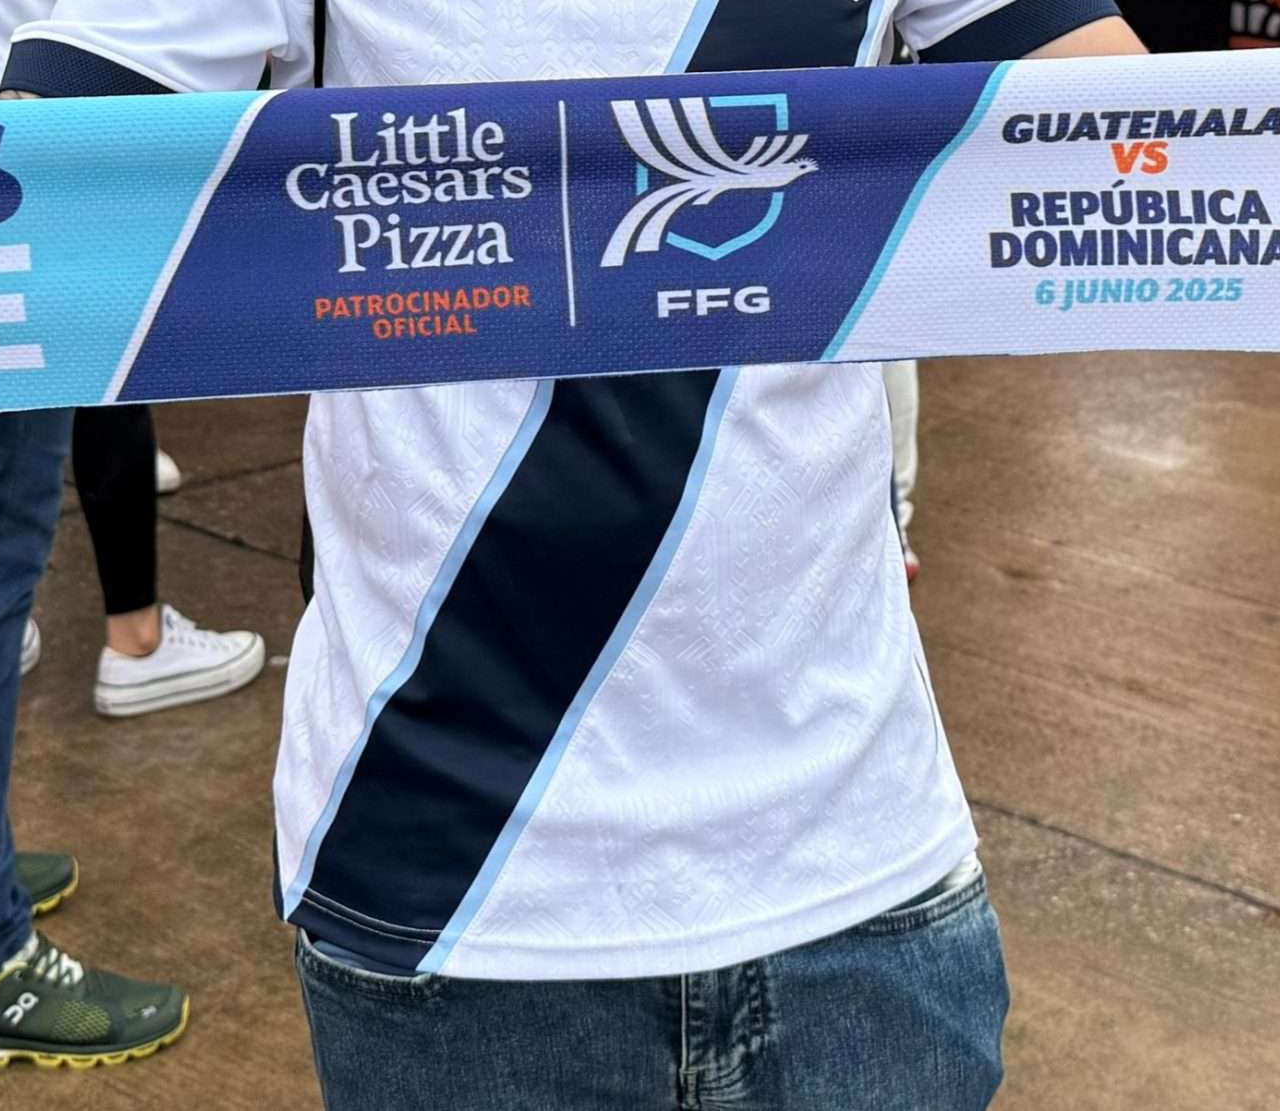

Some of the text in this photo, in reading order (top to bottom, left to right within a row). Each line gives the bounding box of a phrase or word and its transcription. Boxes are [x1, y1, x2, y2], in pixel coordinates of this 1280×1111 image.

[330, 107, 506, 168] Little
[1110, 140, 1170, 175] VS
[285, 162, 533, 211] Caesars
[1009, 178, 1273, 228] REPÚBLICA
[334, 213, 514, 274] Pizza
[314, 284, 531, 320] PATROCINADOR
[656, 285, 772, 319] FFG
[1033, 276, 1246, 312] 6 JUNIO 2025
[373, 314, 477, 340] OFICIAL
